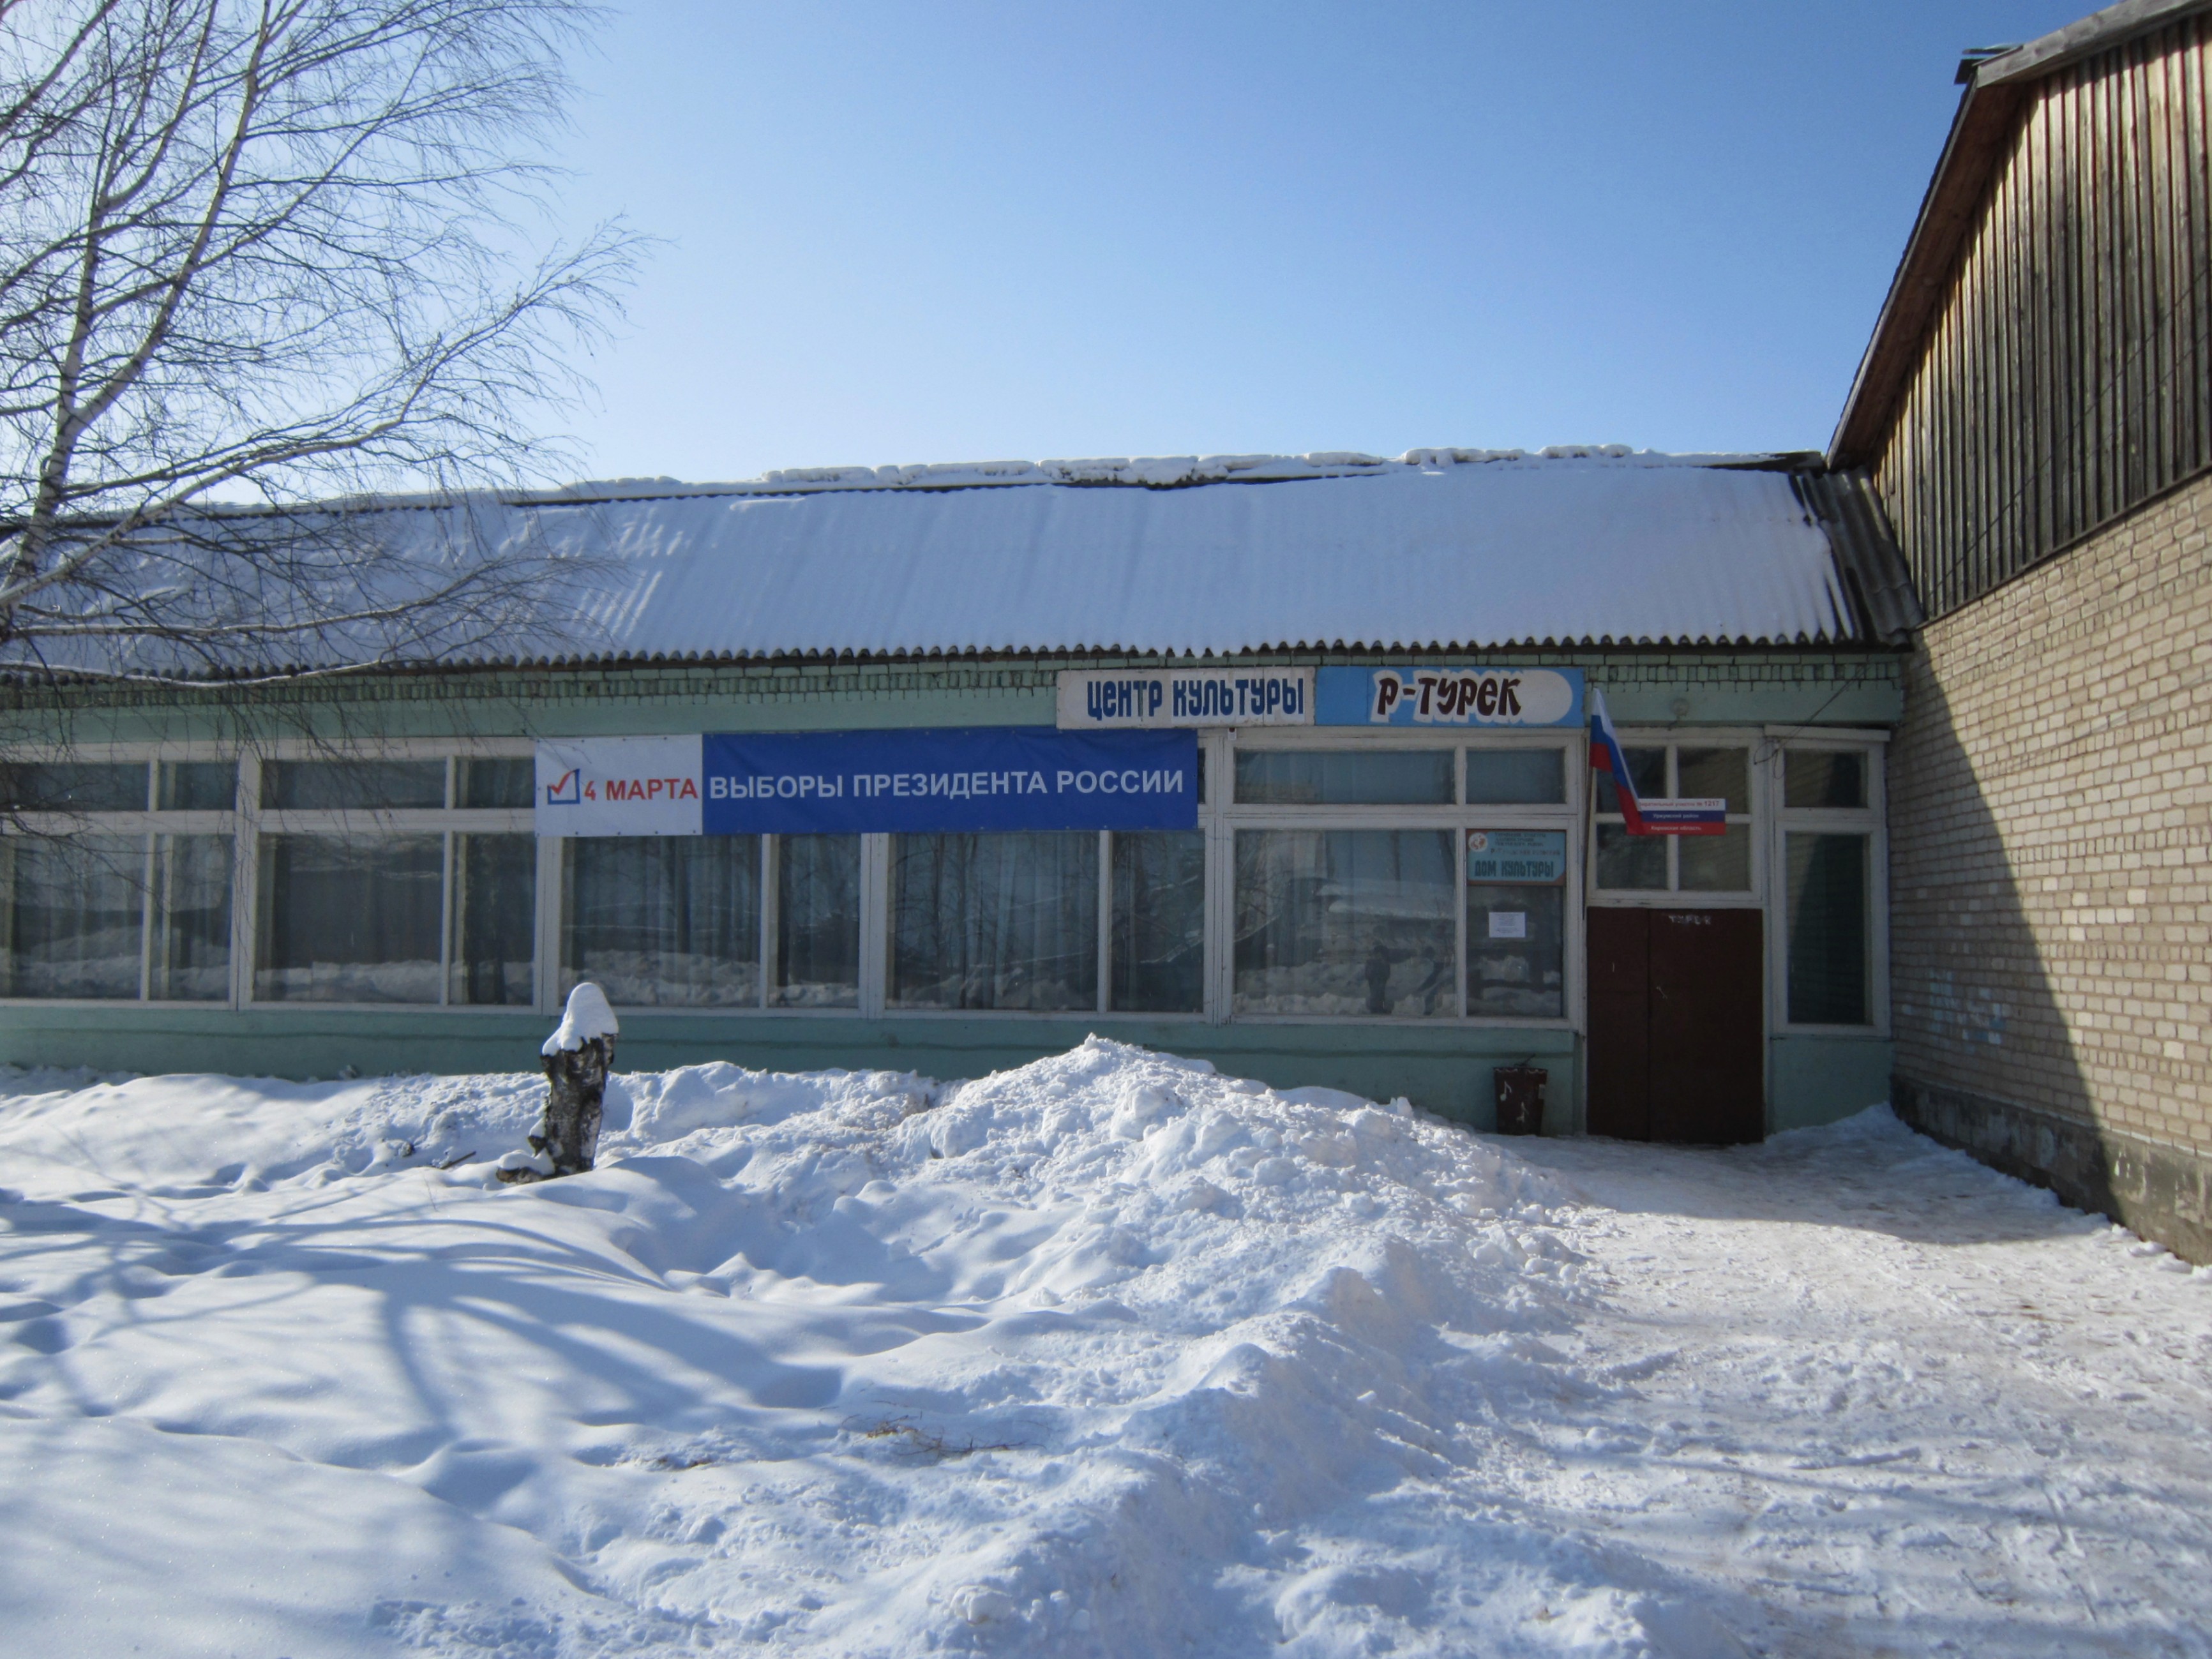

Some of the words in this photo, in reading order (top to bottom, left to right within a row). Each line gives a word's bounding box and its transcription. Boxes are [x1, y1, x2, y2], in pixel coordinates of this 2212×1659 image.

[1173, 678, 1304, 717] КУЛЬТУРЫ
[583, 781, 597, 801] 4
[606, 777, 699, 800] МАРТА
[710, 774, 843, 799] ВЫБОРЫ
[854, 770, 1048, 800] ПРЕЗИДЕНТА
[1057, 770, 1183, 794] РОССИИ
[1475, 860, 1497, 877] ДОМ
[1501, 860, 1554, 878] КУЛЬТУРЫ
